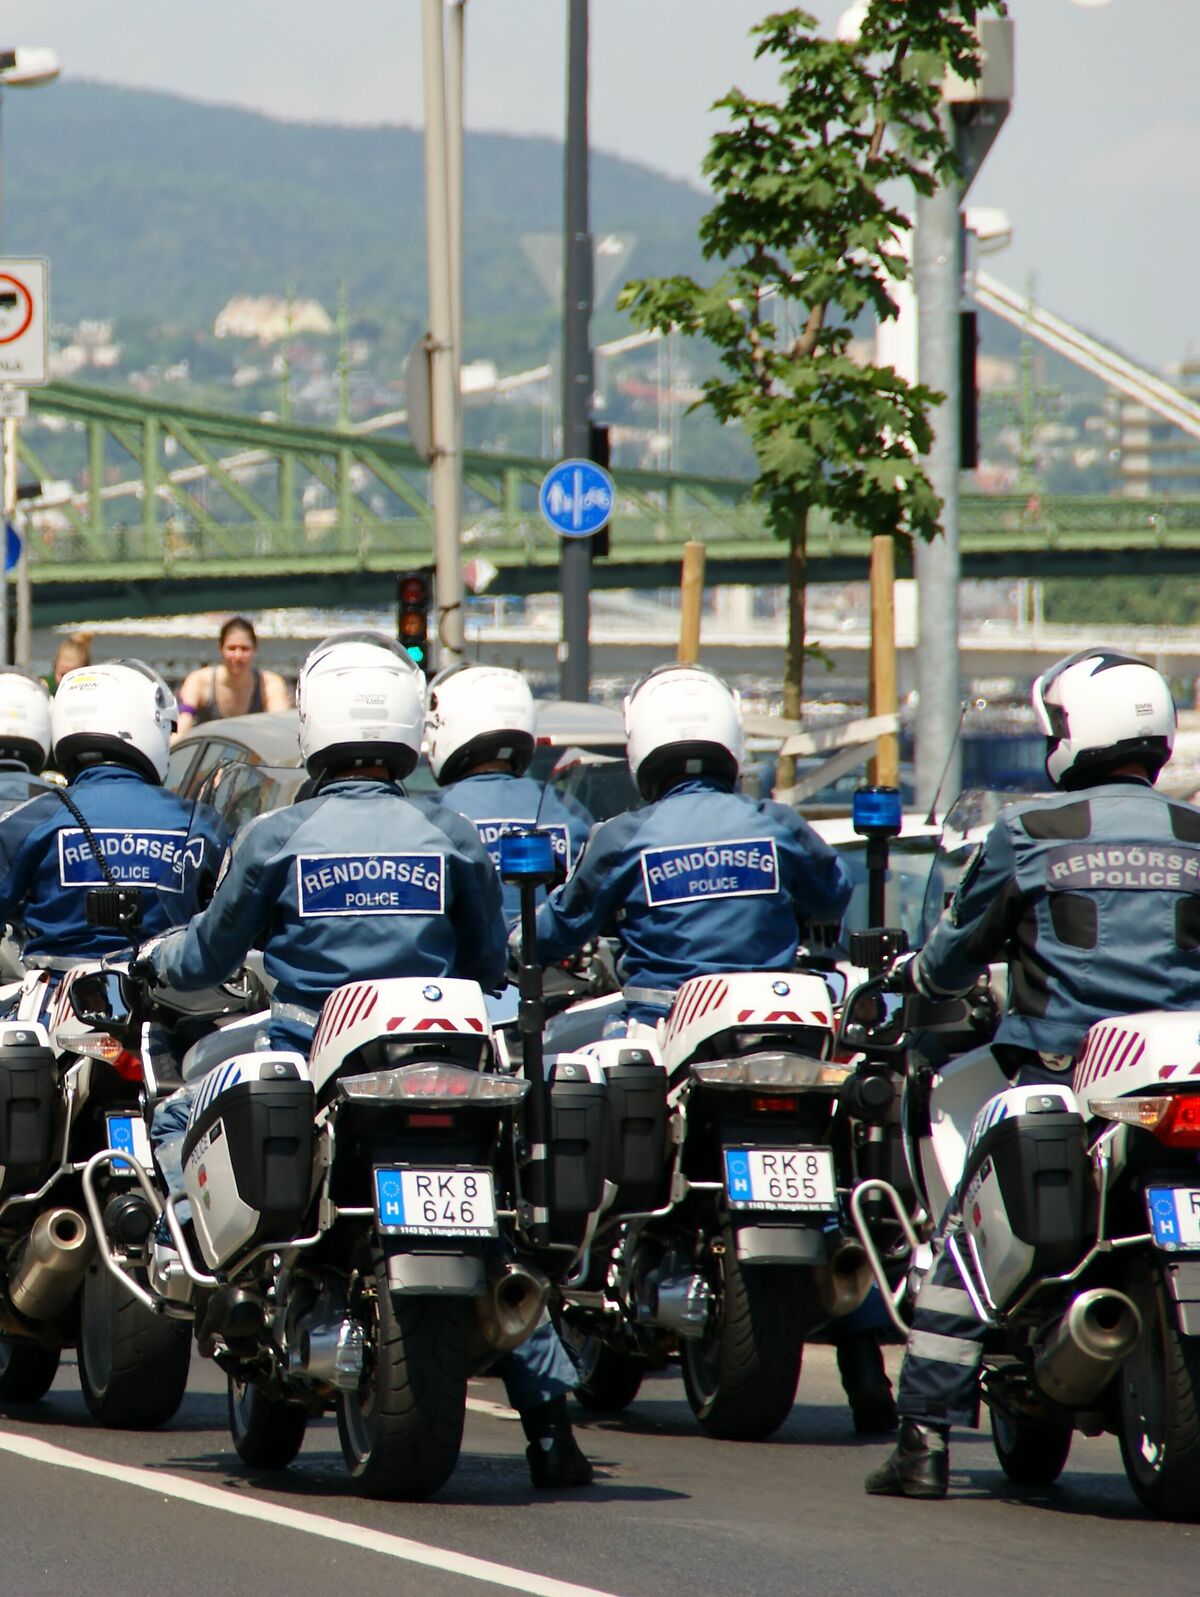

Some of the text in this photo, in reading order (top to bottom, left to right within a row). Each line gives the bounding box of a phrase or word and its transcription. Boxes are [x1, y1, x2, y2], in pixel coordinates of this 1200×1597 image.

[103, 866, 150, 879] OLICE
[648, 847, 774, 885] RENDŐRSÉG
[1052, 847, 1200, 880] RENDŐRSÉ
[304, 856, 440, 894] RENDŐRSÉG
[1090, 871, 1180, 886] POLICE
[689, 877, 738, 893] POLICE
[345, 892, 399, 906] POLICE
[762, 1154, 818, 1175] RK 8
[416, 1175, 478, 1198] RK 8
[734, 1178, 748, 1192] H
[769, 1177, 817, 1199] 655
[386, 1201, 400, 1216] H
[423, 1200, 474, 1223] 646
[1161, 1220, 1175, 1234] H
